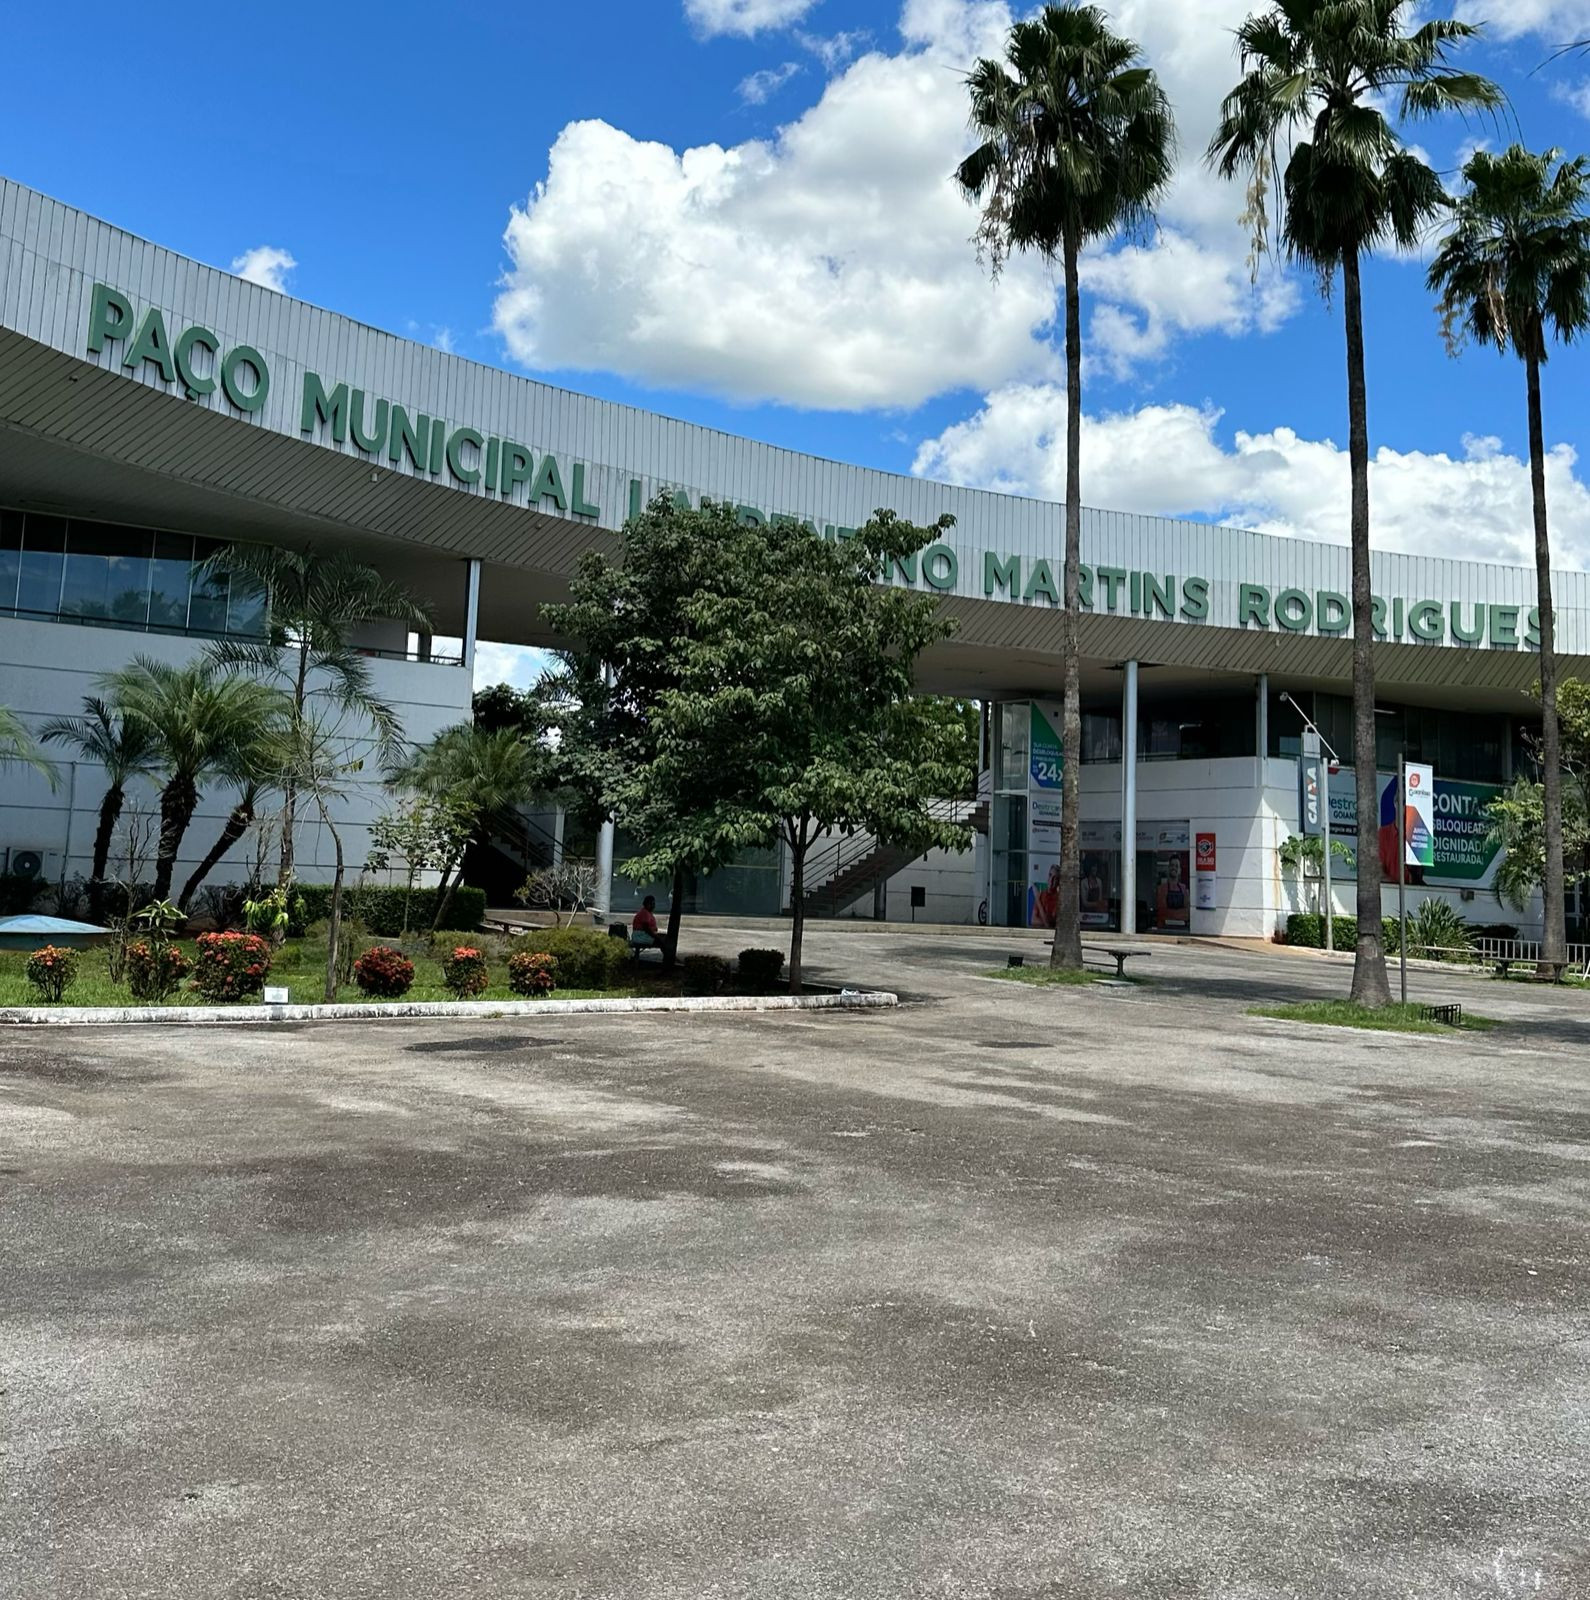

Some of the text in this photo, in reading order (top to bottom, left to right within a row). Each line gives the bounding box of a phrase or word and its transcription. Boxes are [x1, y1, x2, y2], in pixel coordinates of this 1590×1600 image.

[87, 283, 1557, 646] PAÇO MUNICIPAL MARTINS RODRIGUES
[1306, 767, 1317, 824] CAIXA
